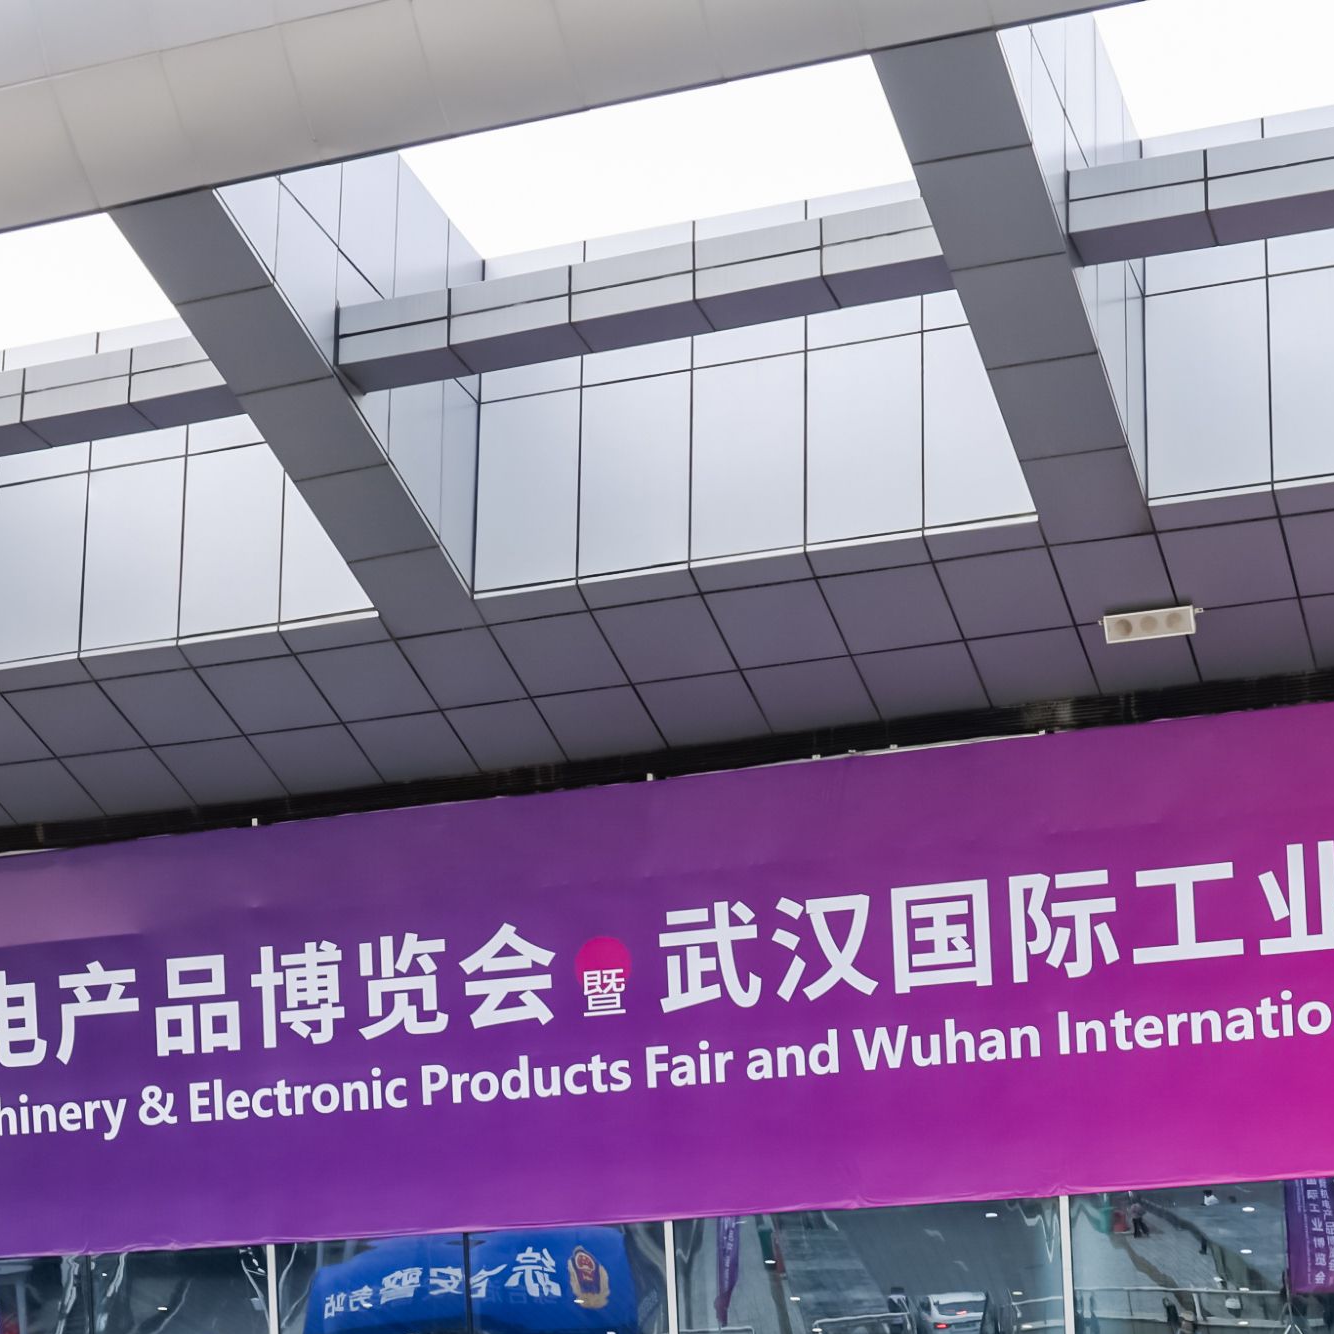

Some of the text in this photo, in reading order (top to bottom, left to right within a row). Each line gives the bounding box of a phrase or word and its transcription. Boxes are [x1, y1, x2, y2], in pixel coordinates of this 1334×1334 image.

[582, 968, 627, 1017] 暨
[138, 1085, 178, 1126] &
[189, 1067, 408, 1123] Electronic
[421, 1054, 632, 1106] Products
[645, 1040, 734, 1089] Fair
[746, 1028, 840, 1081] and
[852, 1018, 1041, 1071] Wuhan
